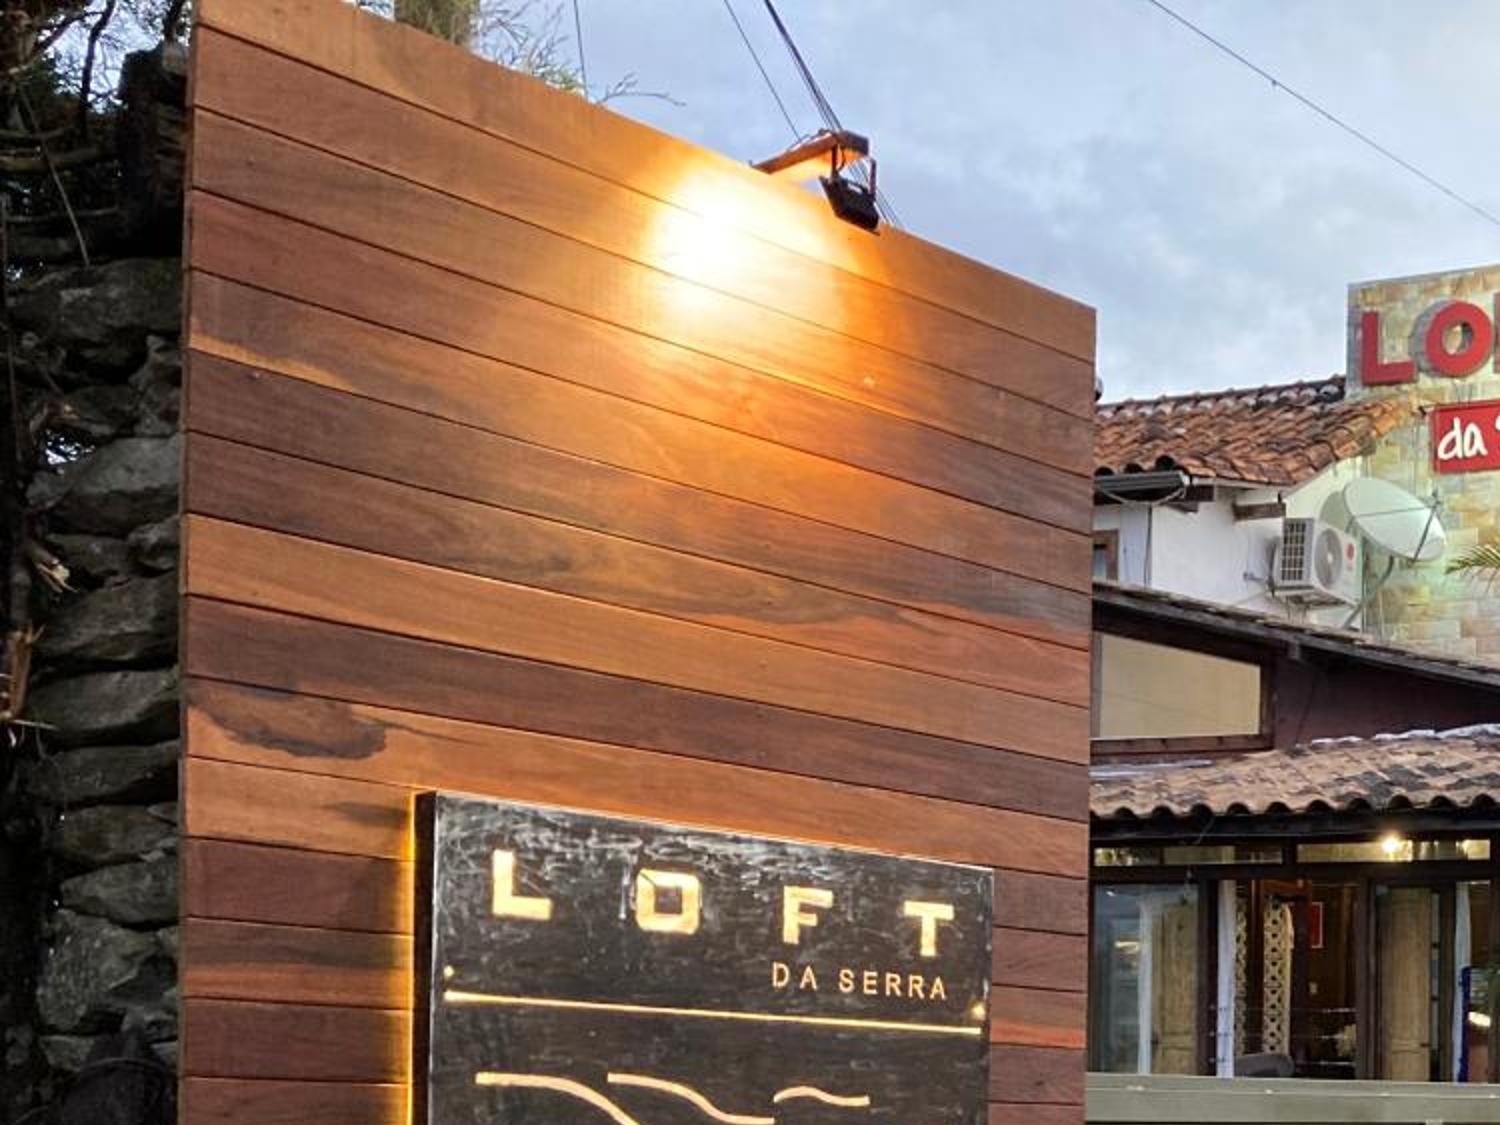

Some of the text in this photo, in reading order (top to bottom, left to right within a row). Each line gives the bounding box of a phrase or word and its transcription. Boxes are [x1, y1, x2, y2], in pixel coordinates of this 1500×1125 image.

[1437, 417, 1488, 461] da
[491, 849, 955, 957] LOFT
[772, 962, 947, 1000] DA SERRA
